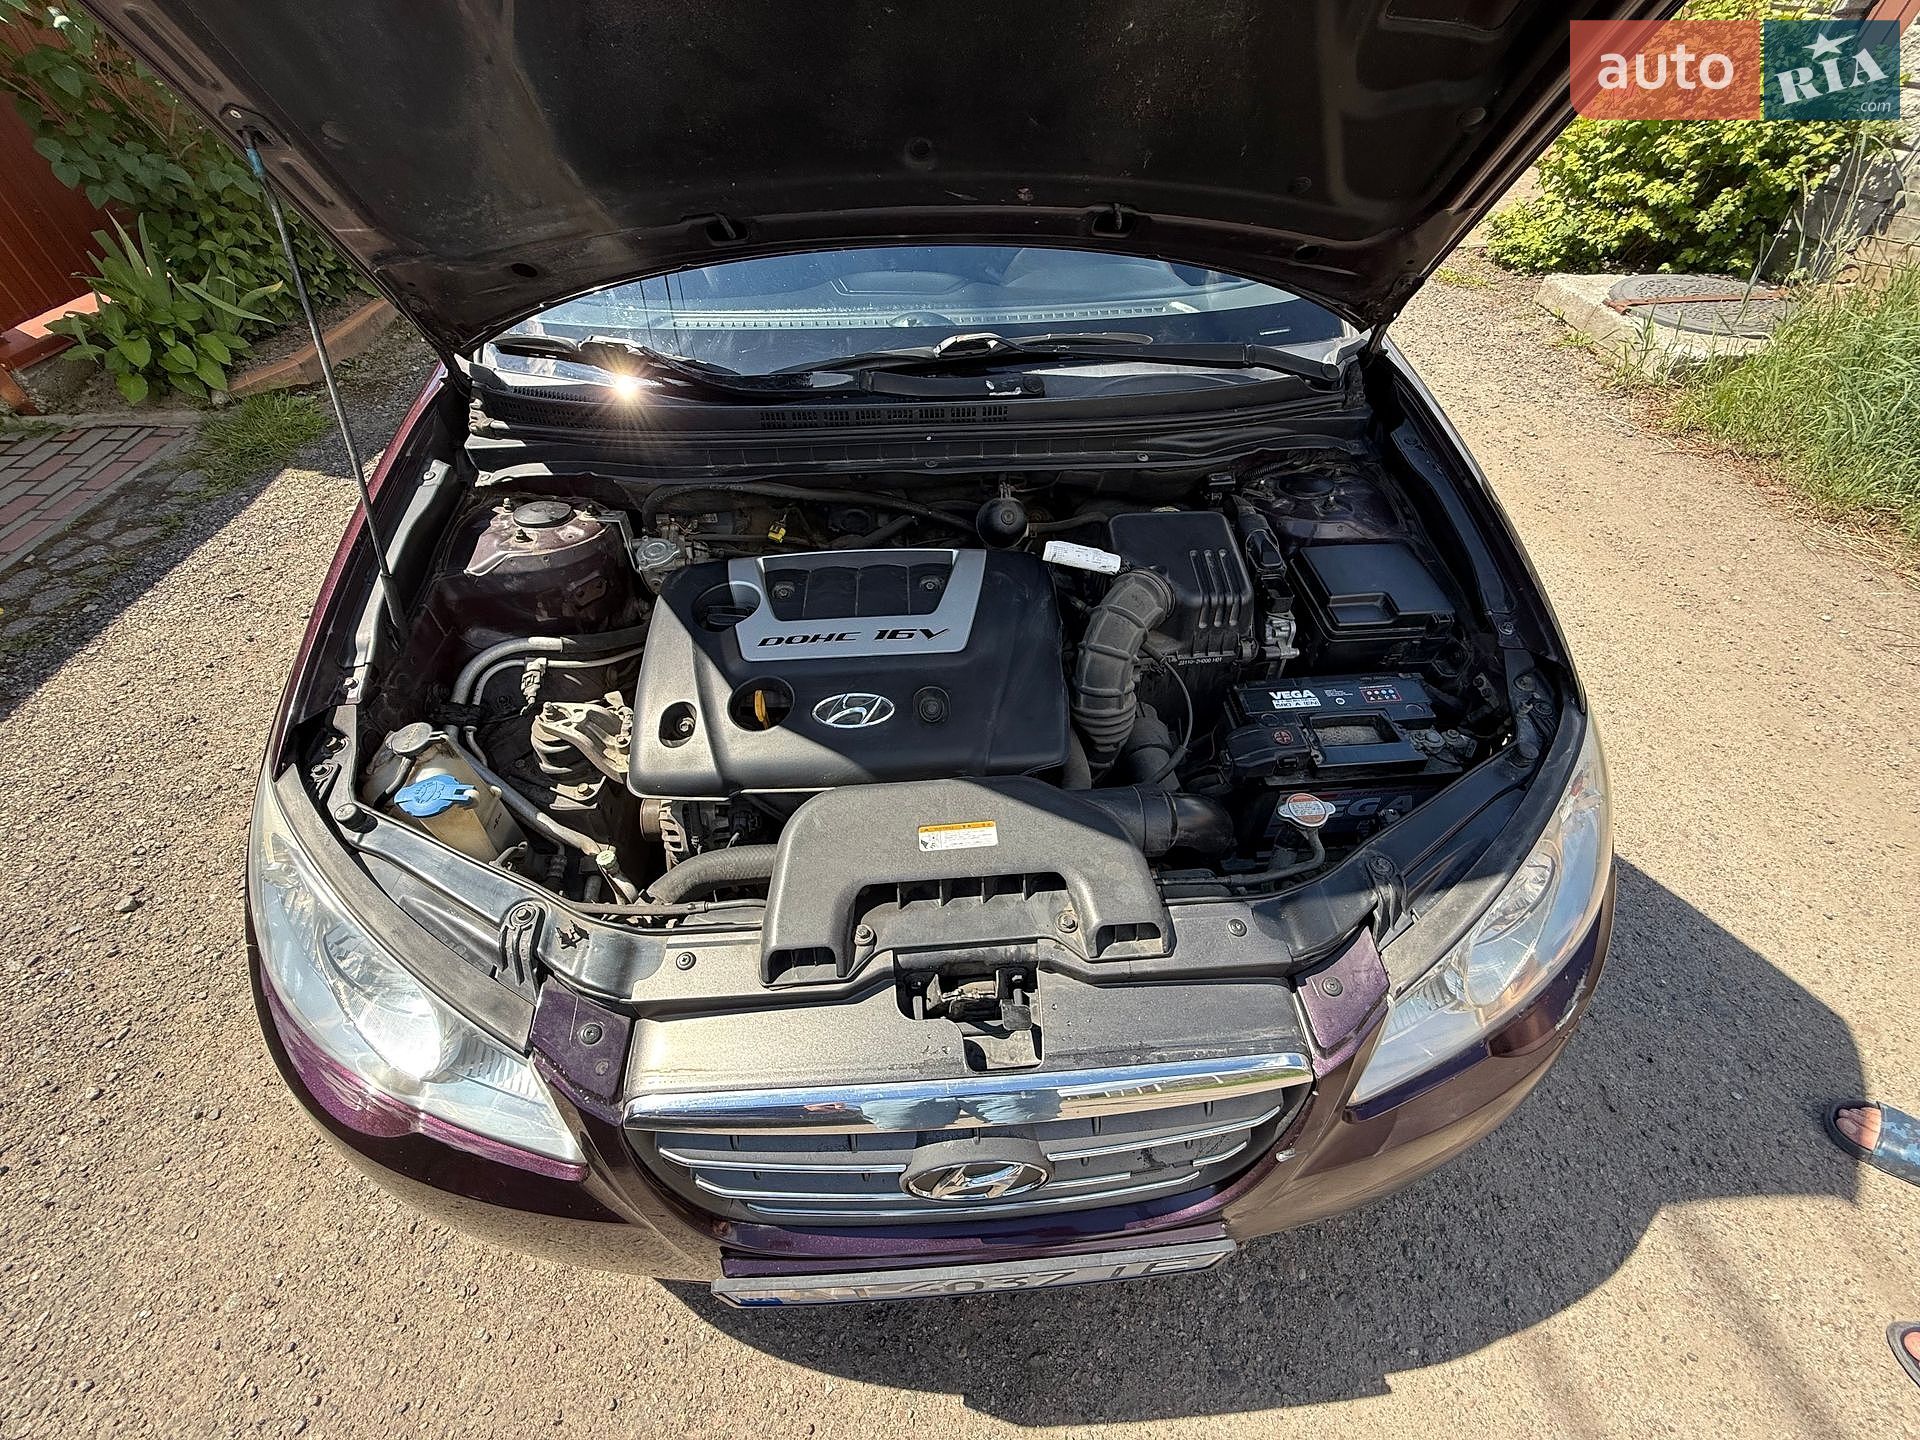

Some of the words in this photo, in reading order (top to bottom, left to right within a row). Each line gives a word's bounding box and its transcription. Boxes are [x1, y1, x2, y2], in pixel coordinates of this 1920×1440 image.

[757, 631, 862, 647] DOHC
[873, 628, 949, 641] 16V
[1269, 690, 1316, 700] VEGA
